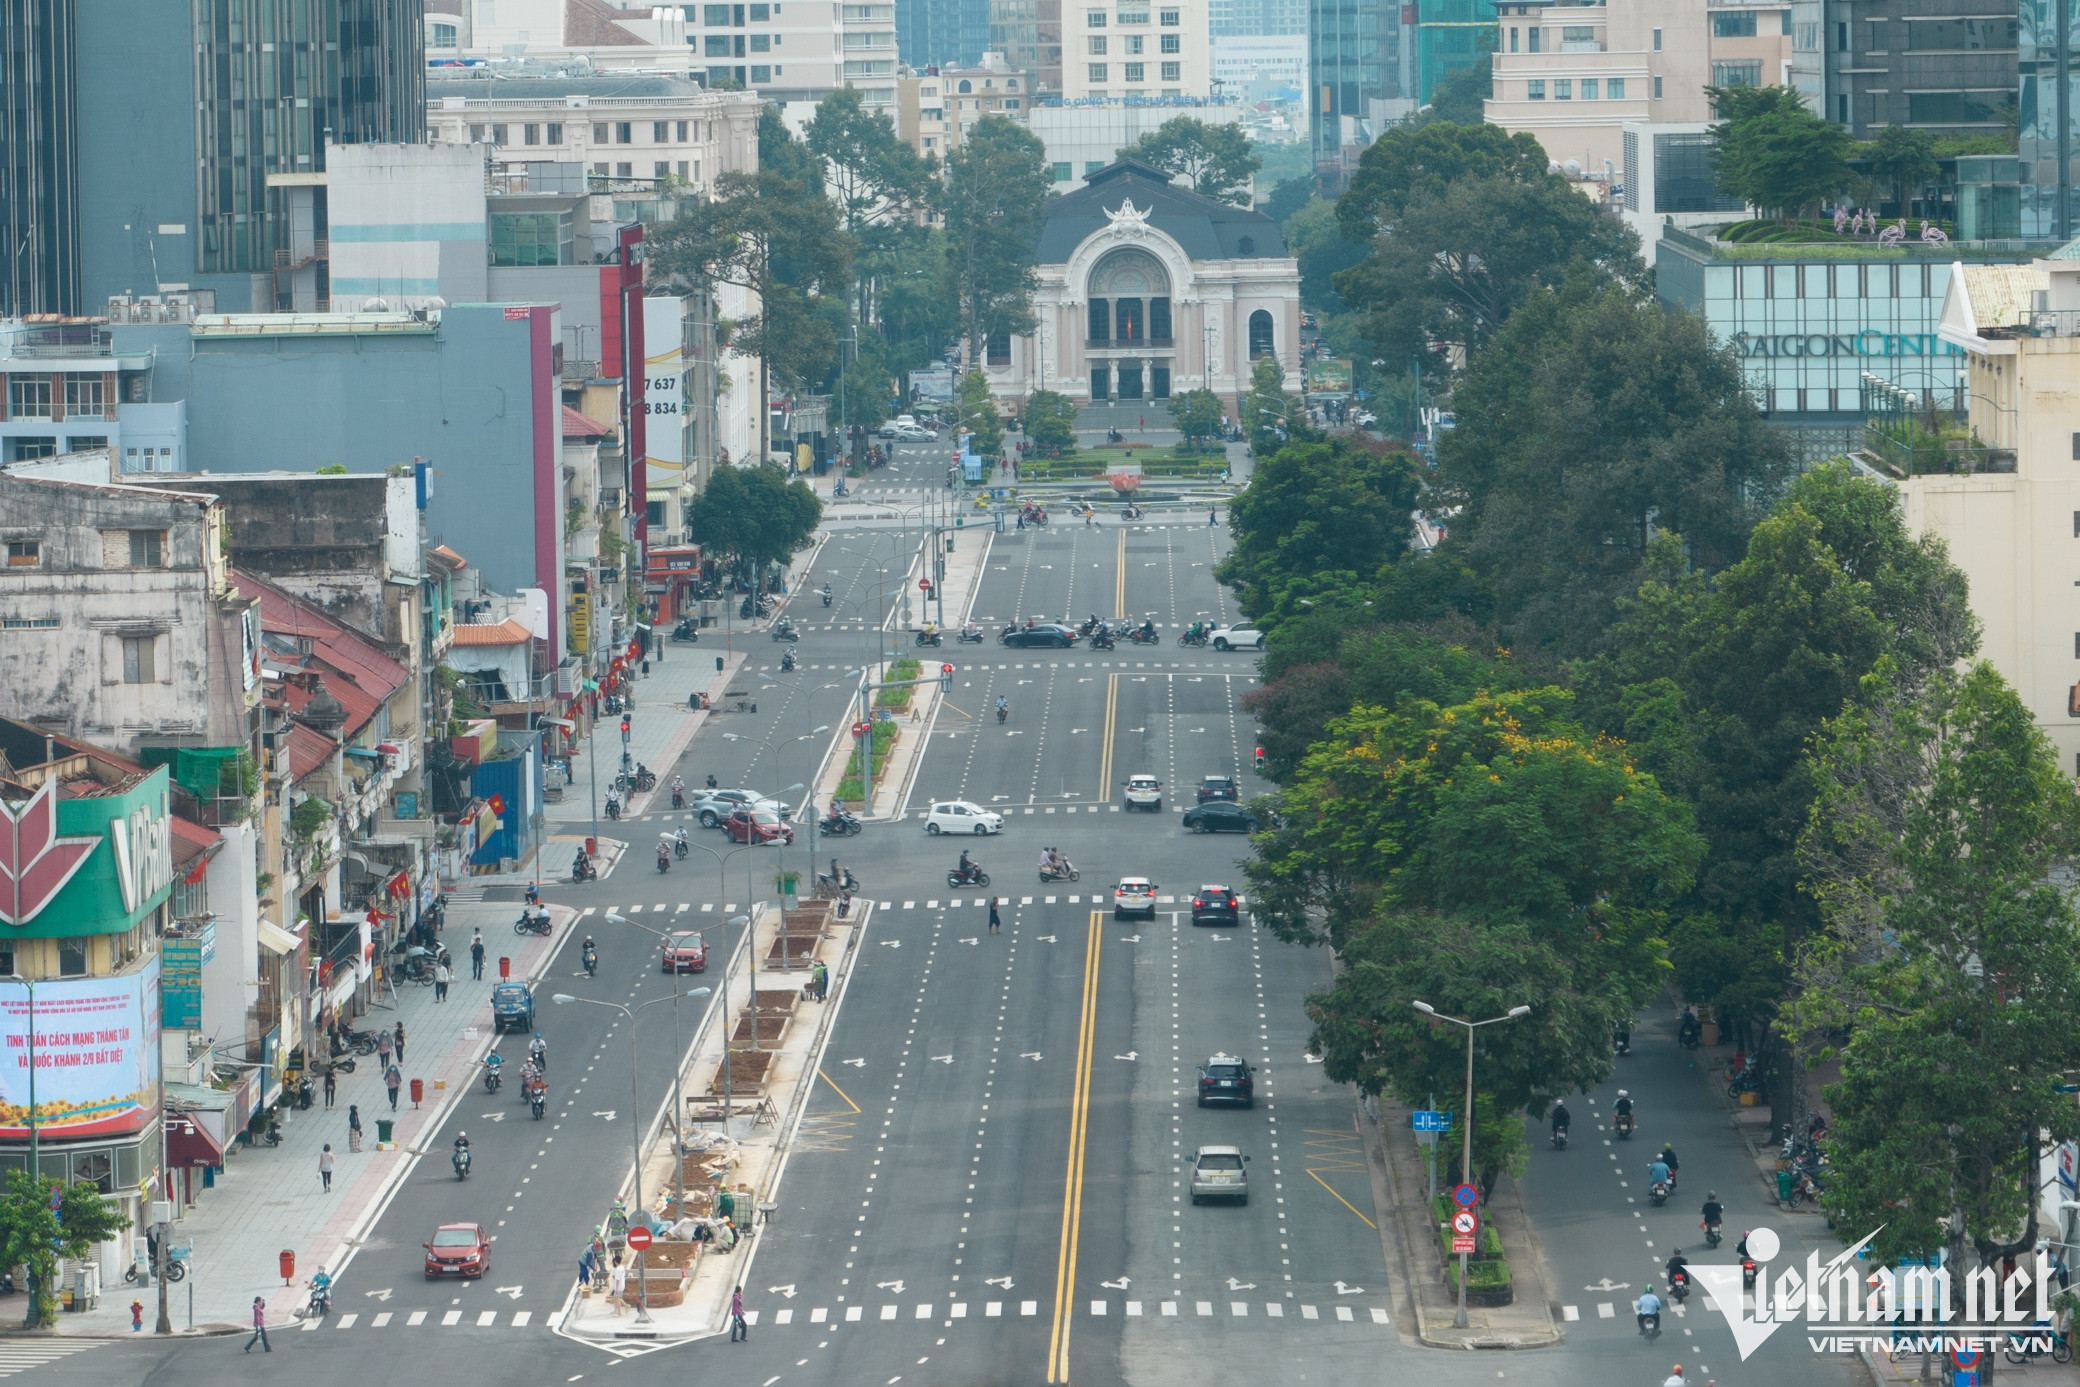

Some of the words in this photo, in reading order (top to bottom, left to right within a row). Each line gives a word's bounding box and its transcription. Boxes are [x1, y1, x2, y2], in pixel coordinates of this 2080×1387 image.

[1107, 97, 1119, 105] TY
[654, 378, 676, 390] 637
[655, 403, 677, 415] 834
[110, 791, 173, 913] VPBank
[6, 1034, 24, 1047] TINH
[49, 1031, 70, 1046] CÁCH
[72, 1031, 95, 1047] MẠNG
[96, 1027, 118, 1044] THÁNG
[119, 1026, 130, 1041] TÁM
[18, 1053, 28, 1068] VÀ
[54, 1051, 81, 1067] KHÁNH
[83, 1053, 94, 1066] 2/9
[96, 1047, 109, 1064] BẤT
[110, 1047, 123, 1065] DIỆT
